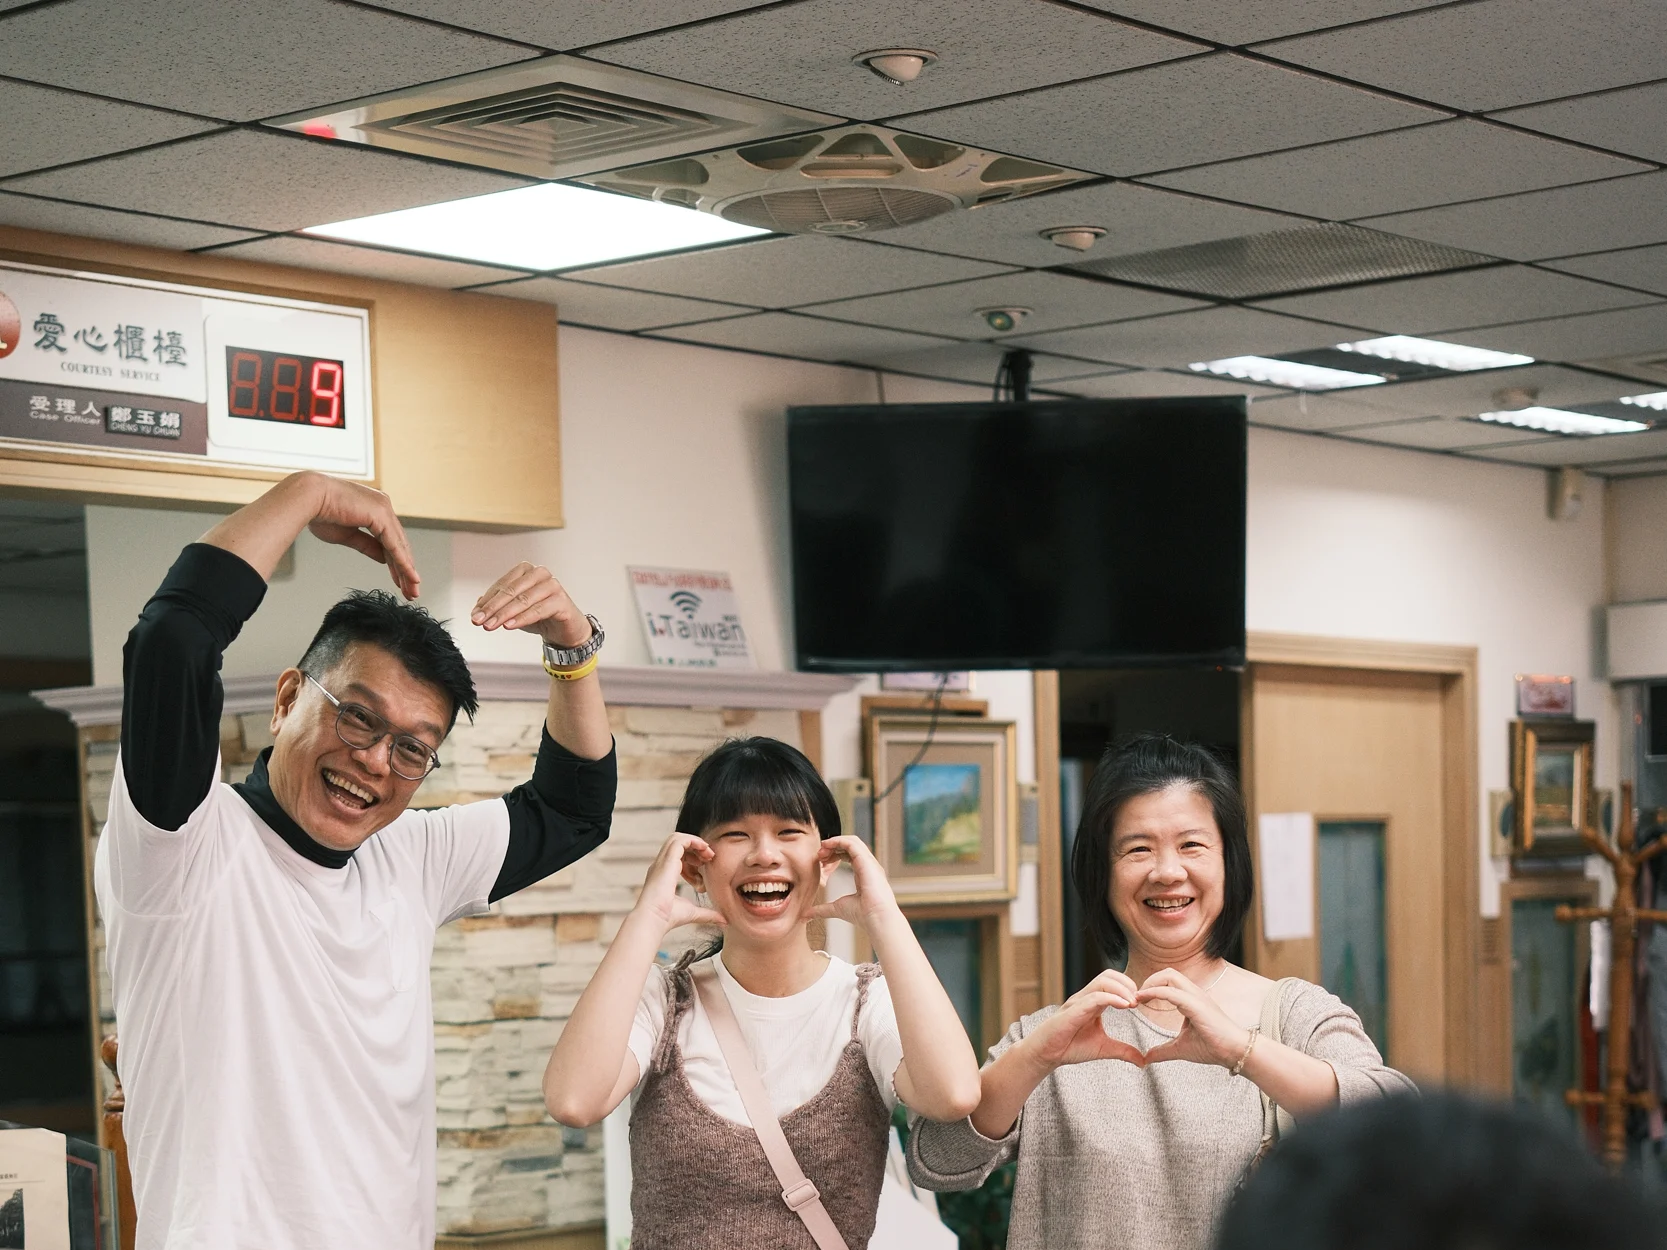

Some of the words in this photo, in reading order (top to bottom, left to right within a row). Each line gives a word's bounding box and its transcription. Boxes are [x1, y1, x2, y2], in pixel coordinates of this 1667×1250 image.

[33, 312, 187, 367] 愛心櫃檯
[60, 361, 113, 377] COURTESY
[120, 369, 160, 381] SERVICE
[29, 395, 101, 416] 受理人
[29, 411, 59, 422] Case
[63, 414, 101, 425] Officer
